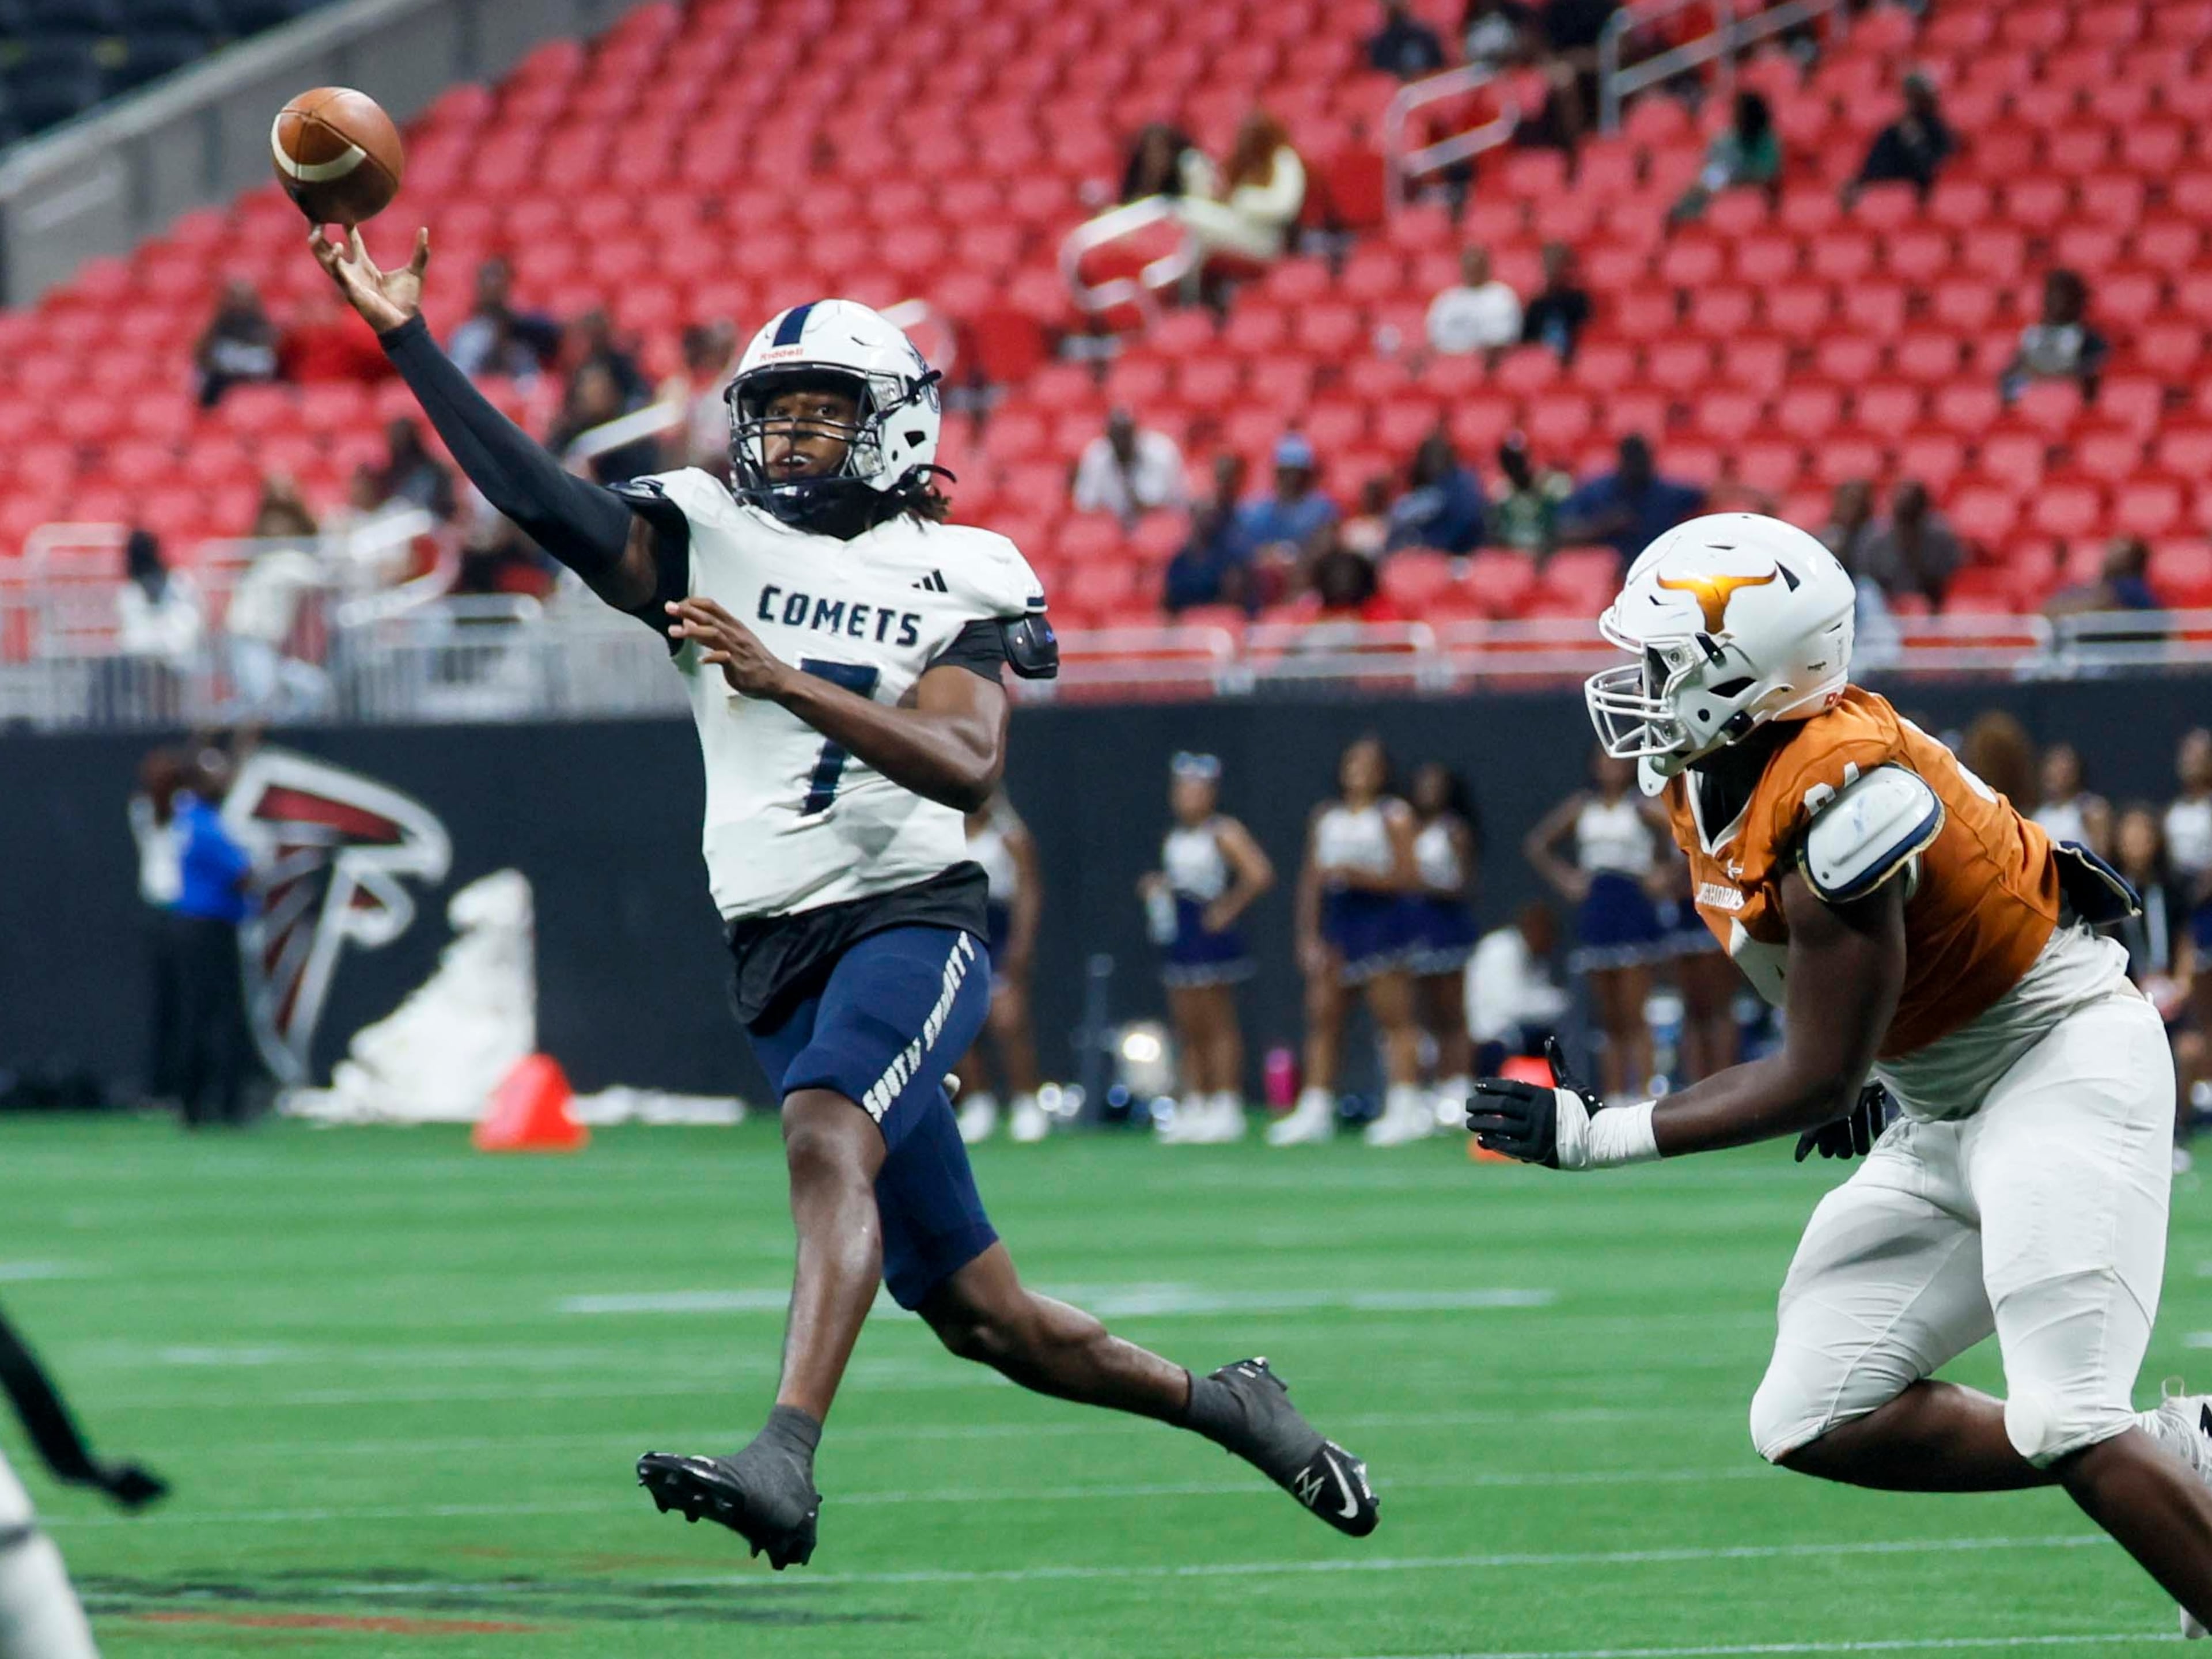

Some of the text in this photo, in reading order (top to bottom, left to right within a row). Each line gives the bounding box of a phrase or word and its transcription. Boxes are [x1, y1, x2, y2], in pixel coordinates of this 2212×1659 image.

[757, 584, 921, 647] COMETS
[798, 657, 881, 818] 7
[862, 1037, 921, 1123] SOUTH
